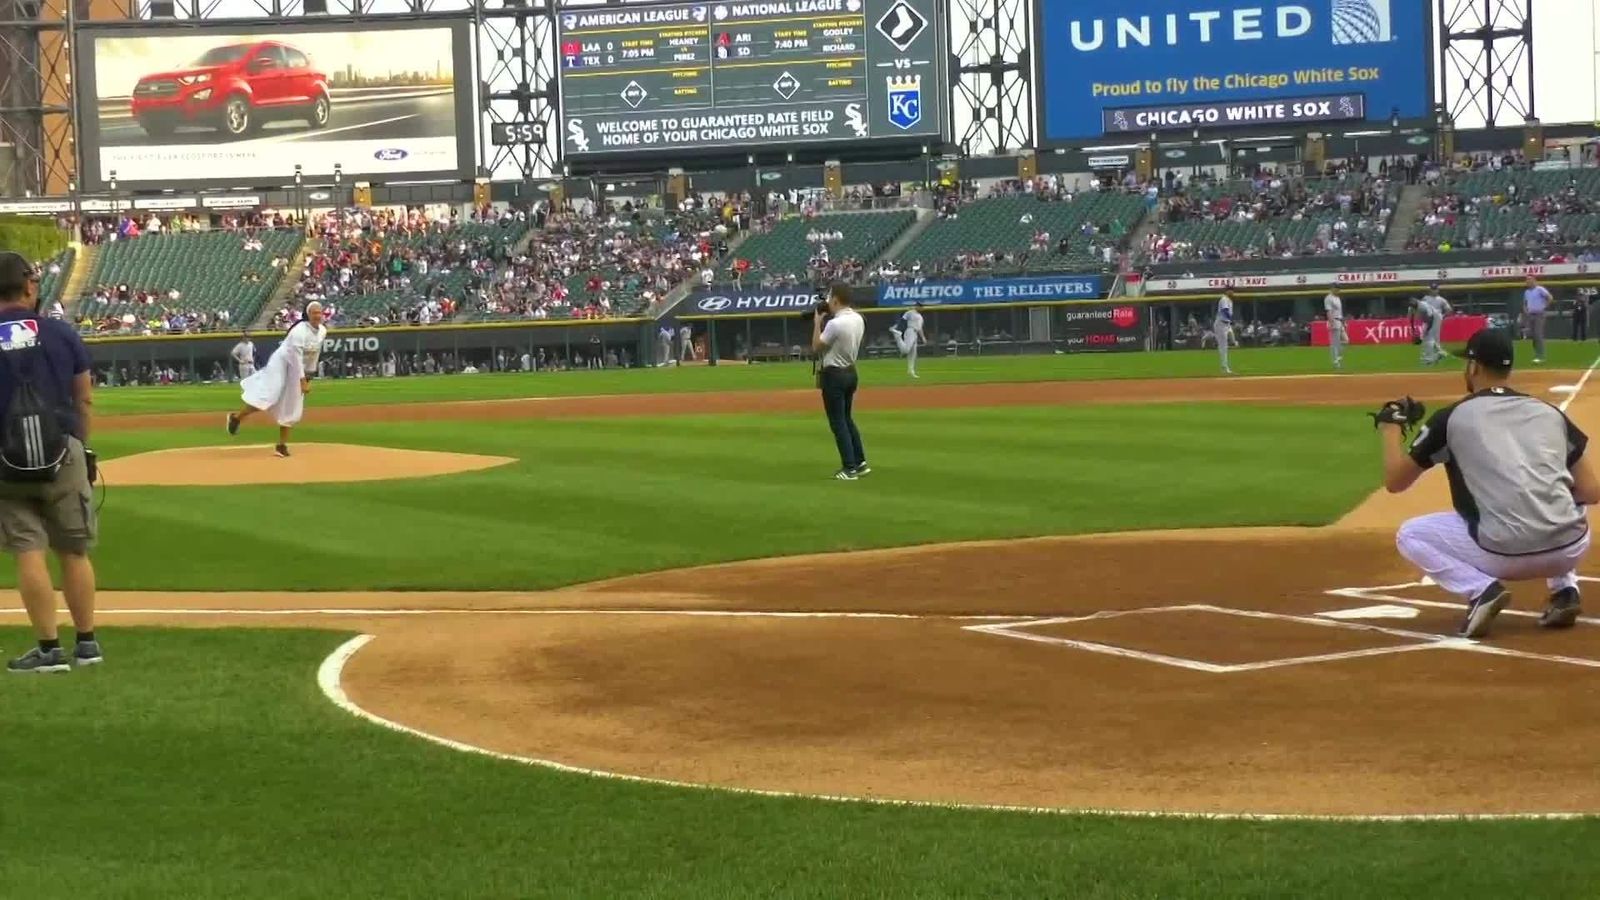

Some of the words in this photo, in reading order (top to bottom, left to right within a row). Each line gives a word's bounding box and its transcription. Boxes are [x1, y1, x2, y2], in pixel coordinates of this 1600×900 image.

[732, 3, 793, 17] NATIONAL
[795, 0, 842, 13] LEAGUE
[578, 12, 641, 27] AMERICAN
[644, 9, 690, 22] LEAGUE
[1070, 5, 1312, 51] UNITED
[735, 33, 751, 42] ARI
[794, 39, 808, 48] PM
[582, 43, 601, 52] LAA
[606, 42, 614, 51] 0
[622, 48, 639, 58] 7:05
[641, 48, 655, 57] PM
[583, 56, 601, 65] TEX
[607, 55, 614, 64] 0
[894, 58, 911, 69] VS
[1092, 79, 1141, 97] Proud
[1145, 79, 1162, 94] to
[1166, 77, 1189, 95] fly
[1193, 76, 1221, 92] the
[1224, 72, 1289, 90] Chicago
[1293, 67, 1345, 85] White
[1348, 66, 1380, 81] Sox
[596, 119, 658, 134] WELCOME
[661, 118, 678, 130] TO
[681, 113, 765, 129] GUARANTEED
[767, 111, 798, 124] RATE
[800, 110, 834, 122] FIELD
[1135, 108, 1219, 127] CHICAGO
[1225, 103, 1286, 121] WHITE
[1292, 100, 1332, 117] SOX
[505, 123, 544, 142] 5:59
[602, 131, 641, 146] HOME
[643, 131, 660, 143] OF
[662, 129, 698, 143] YOUR
[700, 127, 757, 141] CHICAGO
[759, 124, 800, 138] WHITE
[802, 122, 829, 136] SOX
[883, 284, 963, 300] ATHLETICO
[974, 286, 1004, 298] THE
[1008, 282, 1093, 297] RELIEVERS
[736, 294, 820, 309] HYUNDA
[323, 336, 379, 353] PATIO
